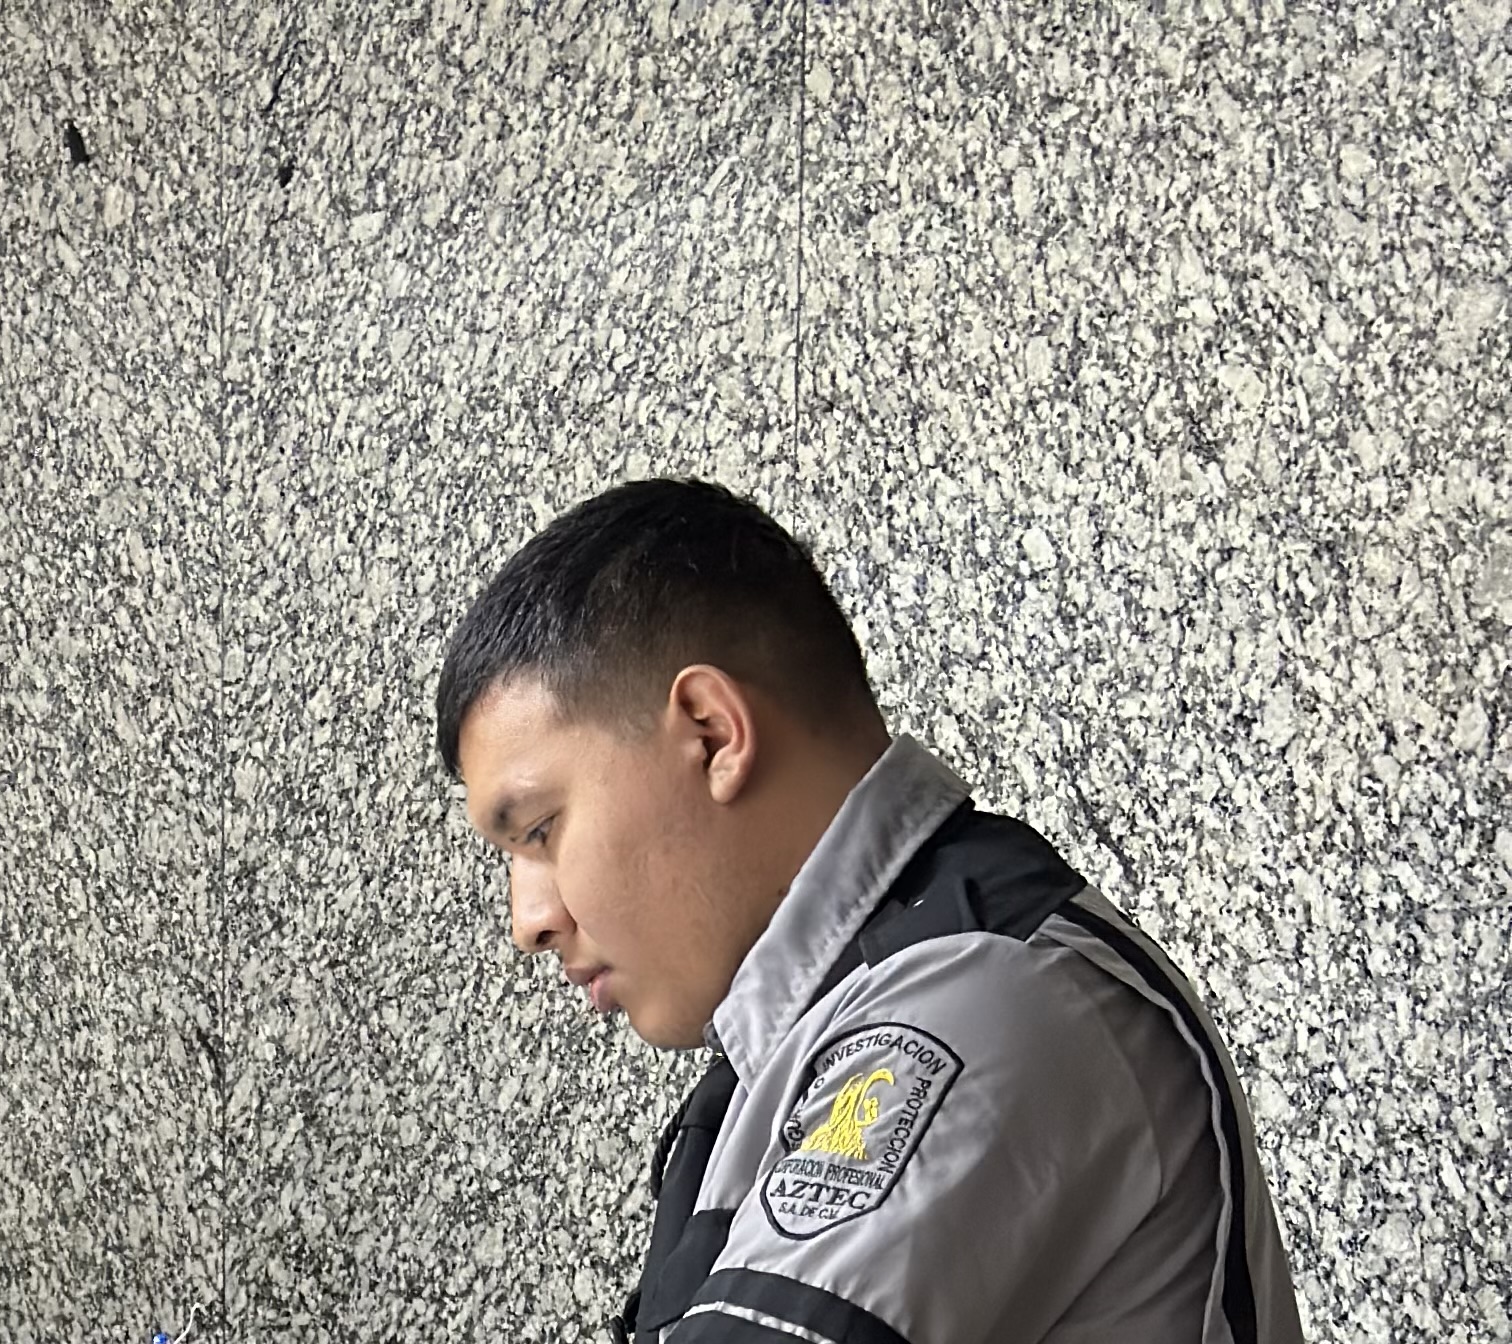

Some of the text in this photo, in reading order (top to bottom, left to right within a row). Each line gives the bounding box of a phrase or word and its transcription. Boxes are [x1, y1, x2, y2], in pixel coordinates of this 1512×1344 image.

[822, 1032, 947, 1076] INVESTIGACION
[876, 1076, 932, 1175] PROTECCION
[769, 1177, 871, 1210] AZTEC
